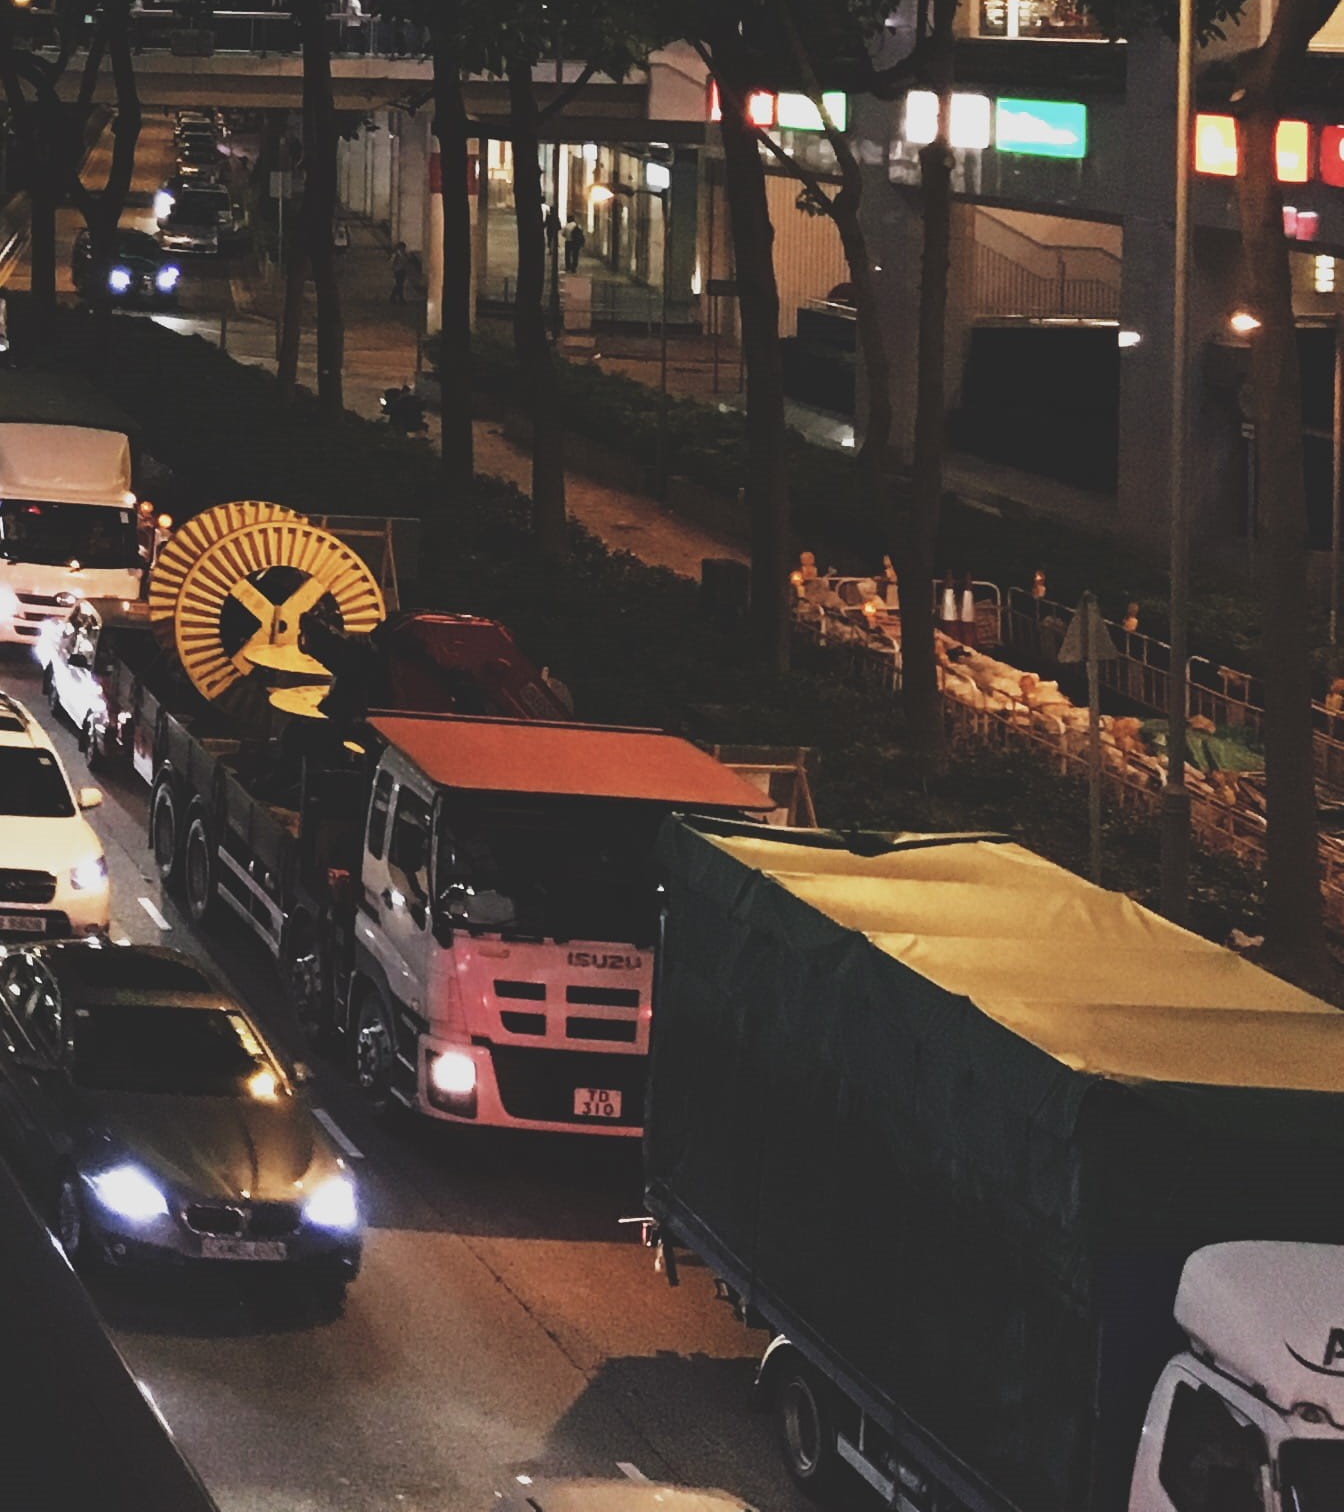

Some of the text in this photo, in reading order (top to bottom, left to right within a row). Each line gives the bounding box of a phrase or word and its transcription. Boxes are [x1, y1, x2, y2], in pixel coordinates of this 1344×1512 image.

[568, 952, 642, 970] ISUZU
[587, 1090, 610, 1103] TD
[581, 1102, 614, 1117] 310
